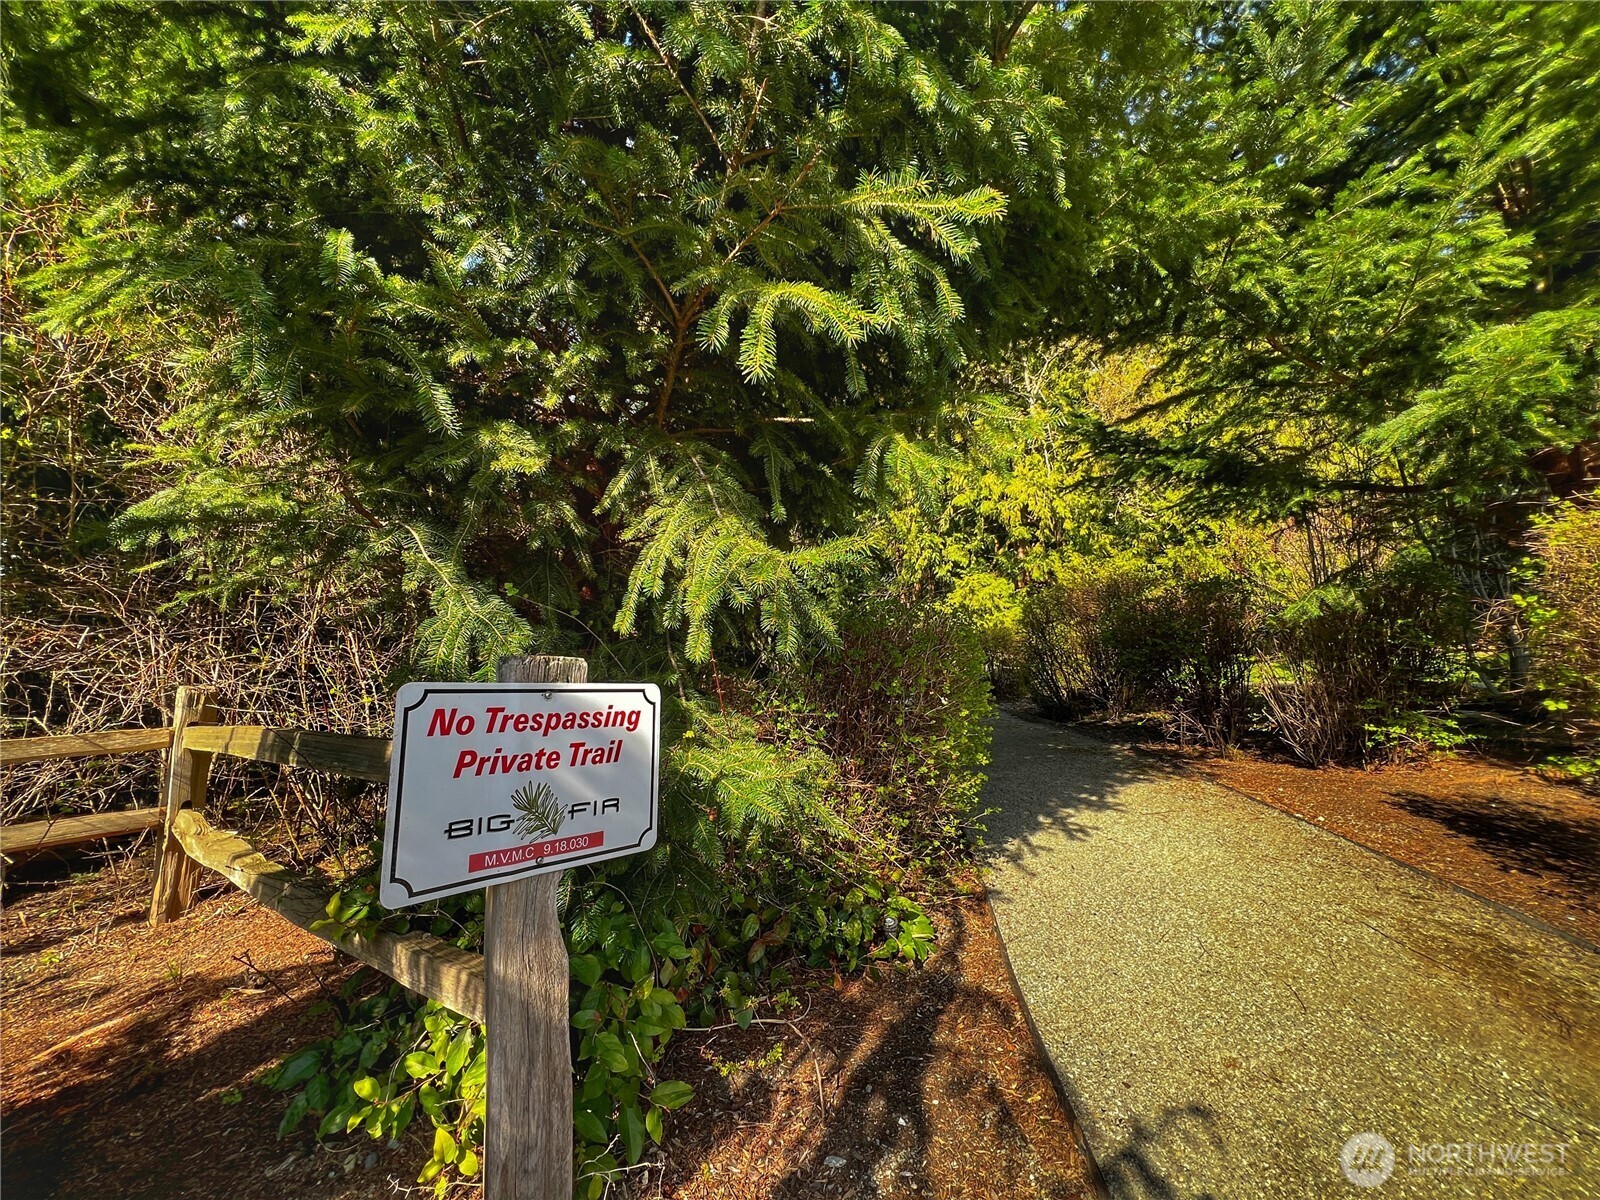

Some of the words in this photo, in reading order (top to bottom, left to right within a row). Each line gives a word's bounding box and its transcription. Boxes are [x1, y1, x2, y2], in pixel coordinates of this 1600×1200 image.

[427, 708, 475, 737] No
[485, 705, 641, 737] Trespassing
[453, 748, 561, 779] Private
[569, 740, 624, 767] Trail
[444, 814, 515, 840] BIG
[568, 798, 620, 820] FIR
[484, 846, 535, 867] M.V.M.C
[543, 836, 589, 855] 9.18.030
